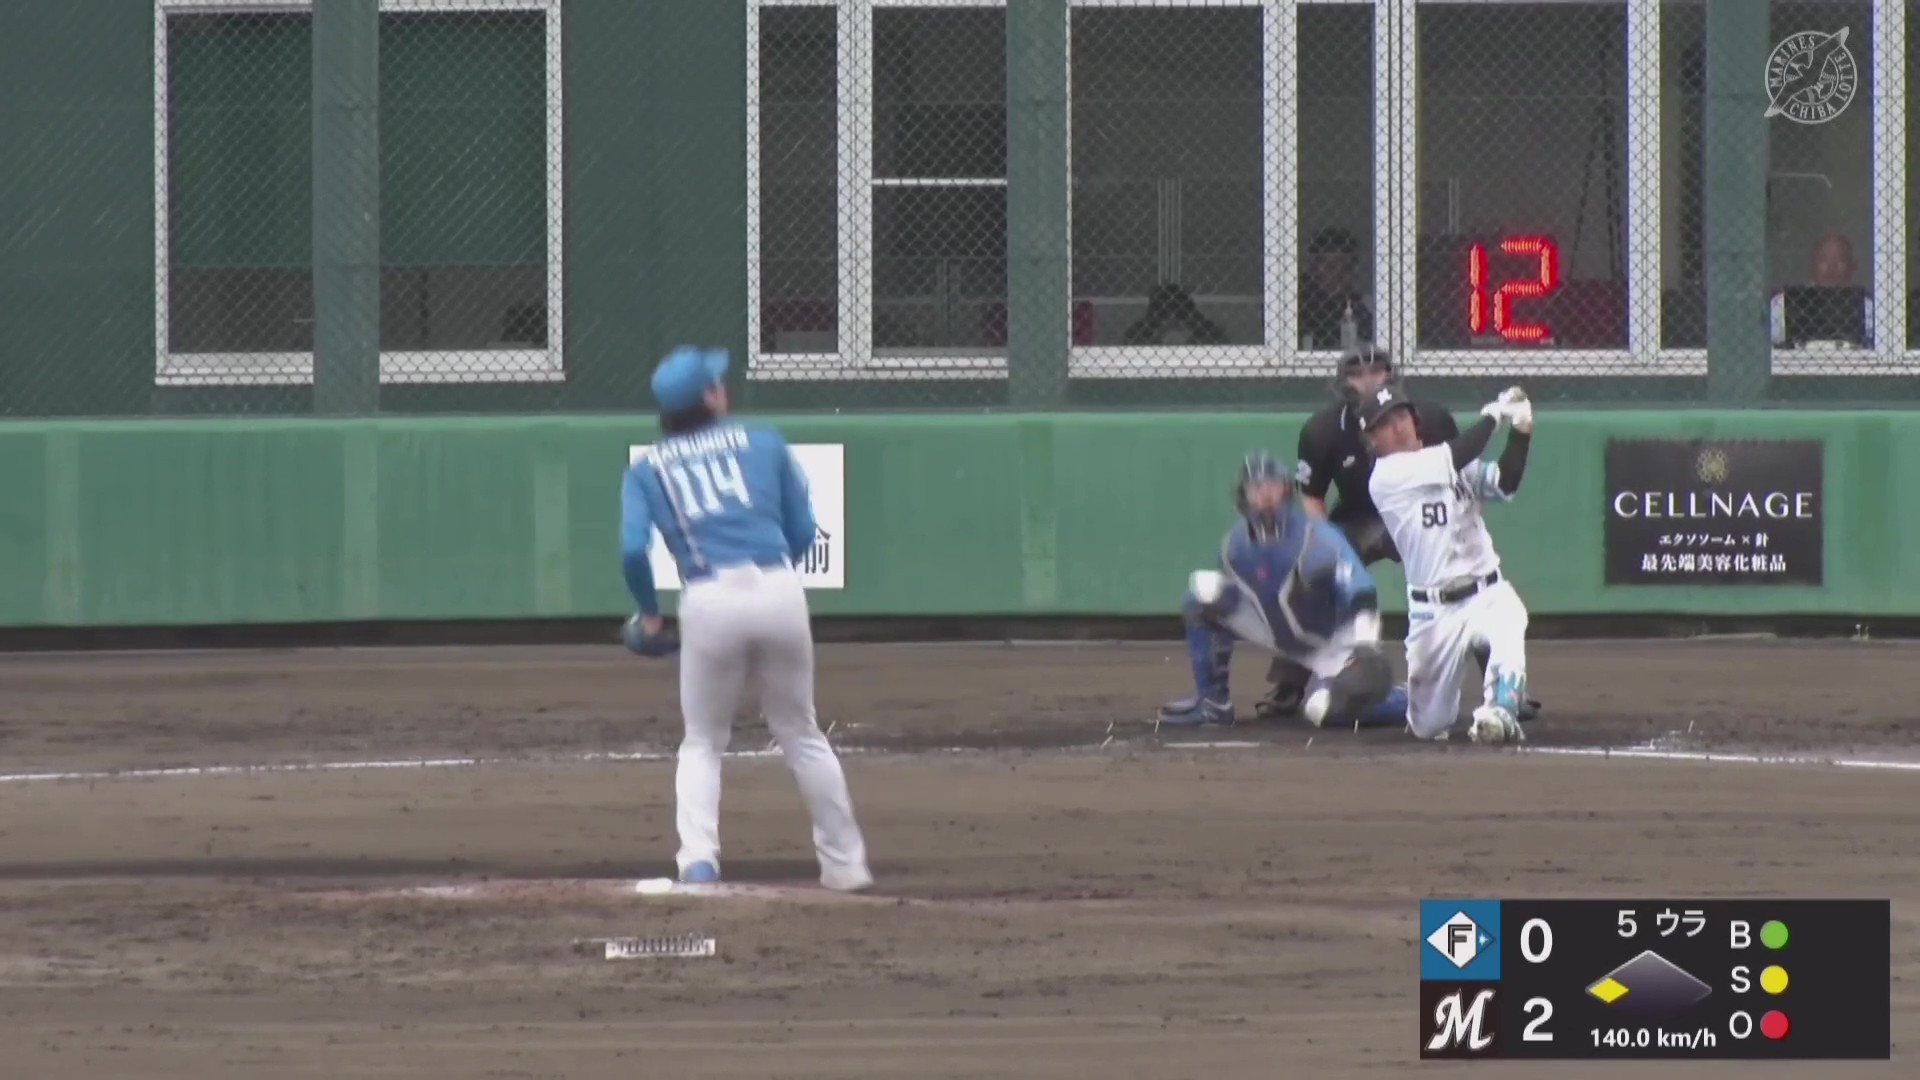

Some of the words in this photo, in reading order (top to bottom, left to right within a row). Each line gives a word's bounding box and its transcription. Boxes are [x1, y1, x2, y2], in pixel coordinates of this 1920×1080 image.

[1470, 237, 1557, 340] 12
[670, 450, 752, 519] 114
[1422, 501, 1447, 528] 50
[1614, 491, 1813, 518] CELLNAGE
[1641, 554, 1786, 572] 最先端美容化粧品
